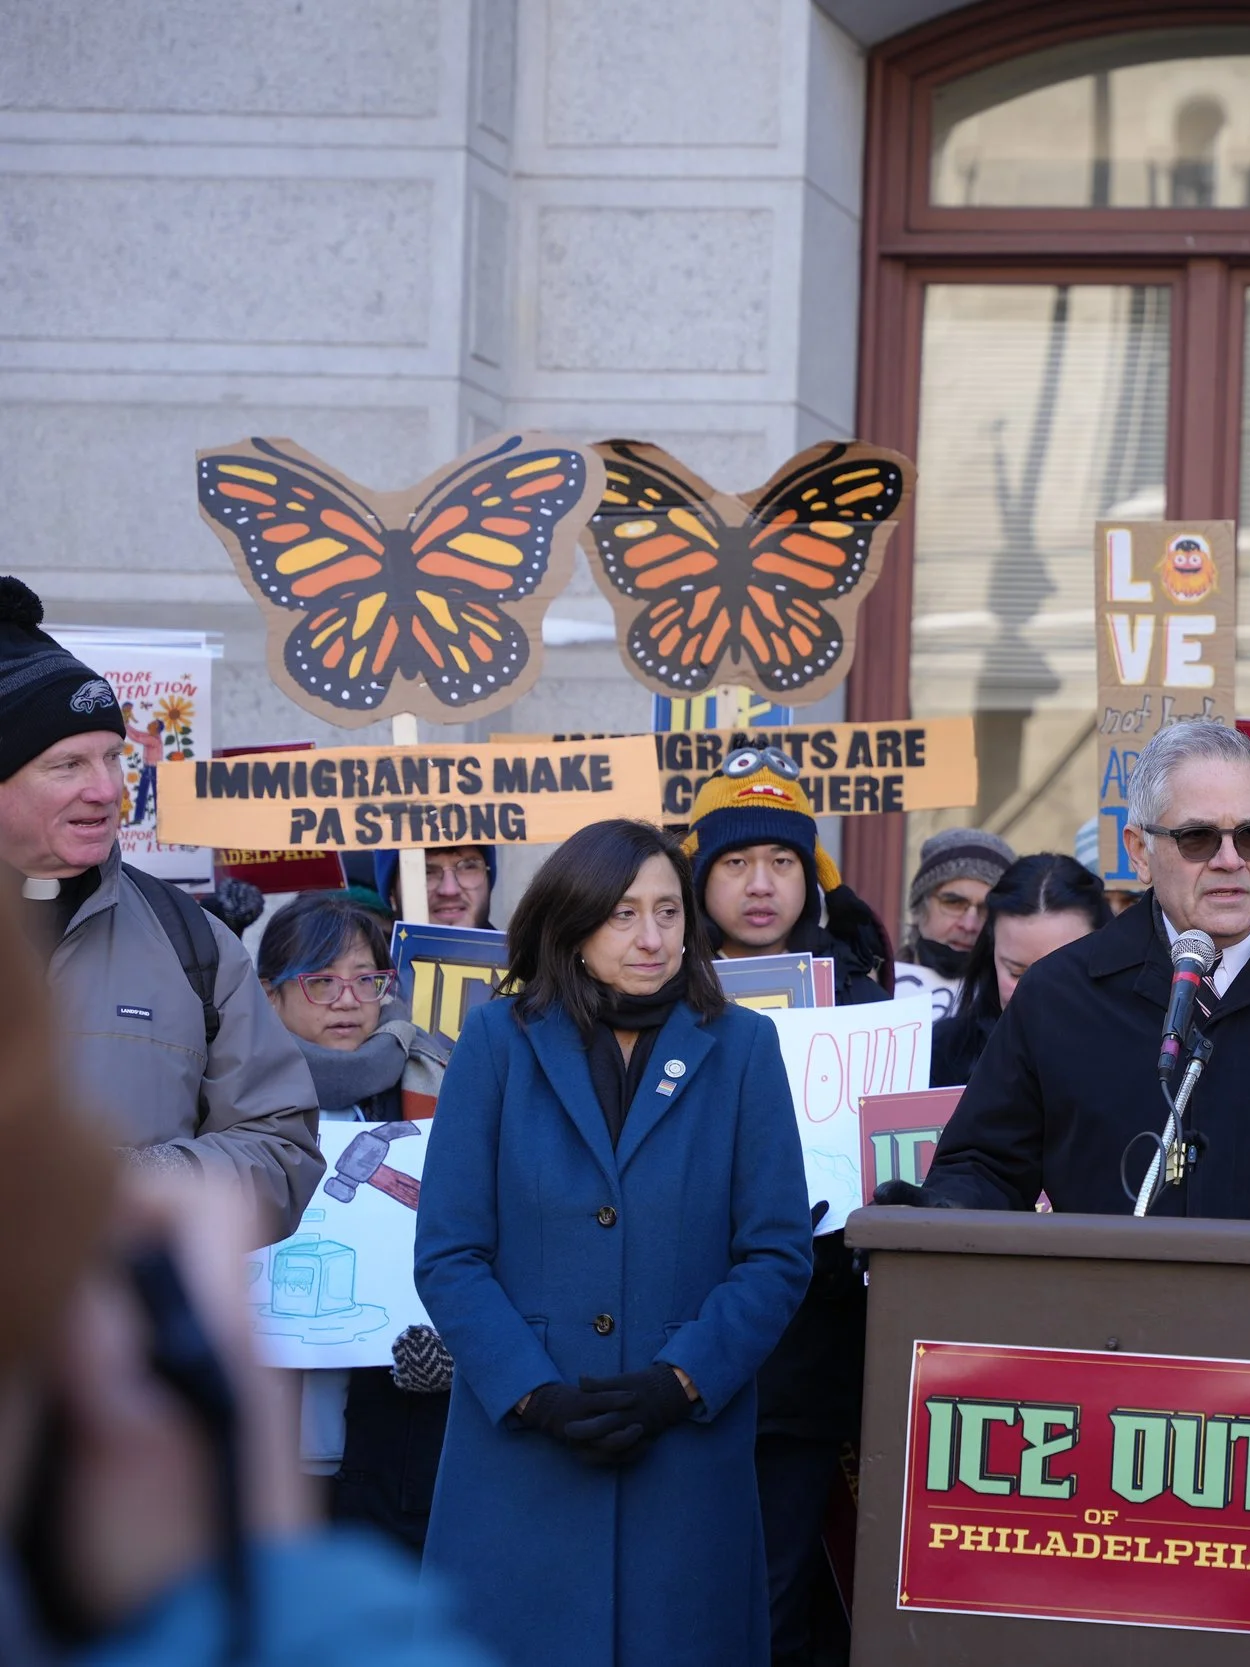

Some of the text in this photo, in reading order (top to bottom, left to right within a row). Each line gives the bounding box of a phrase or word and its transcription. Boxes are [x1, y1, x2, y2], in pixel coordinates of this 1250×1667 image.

[104, 671, 153, 684] MORE
[116, 682, 198, 700] TENTION
[1100, 695, 1151, 734] not
[846, 729, 926, 770] ARE
[194, 754, 613, 800] IMMIGRANTS MAKE
[802, 775, 904, 813] HERE
[289, 802, 527, 845] PA STRONG
[804, 1022, 921, 1122] OUT
[924, 1395, 1081, 1500] ICE
[1084, 1509, 1119, 1525] OF
